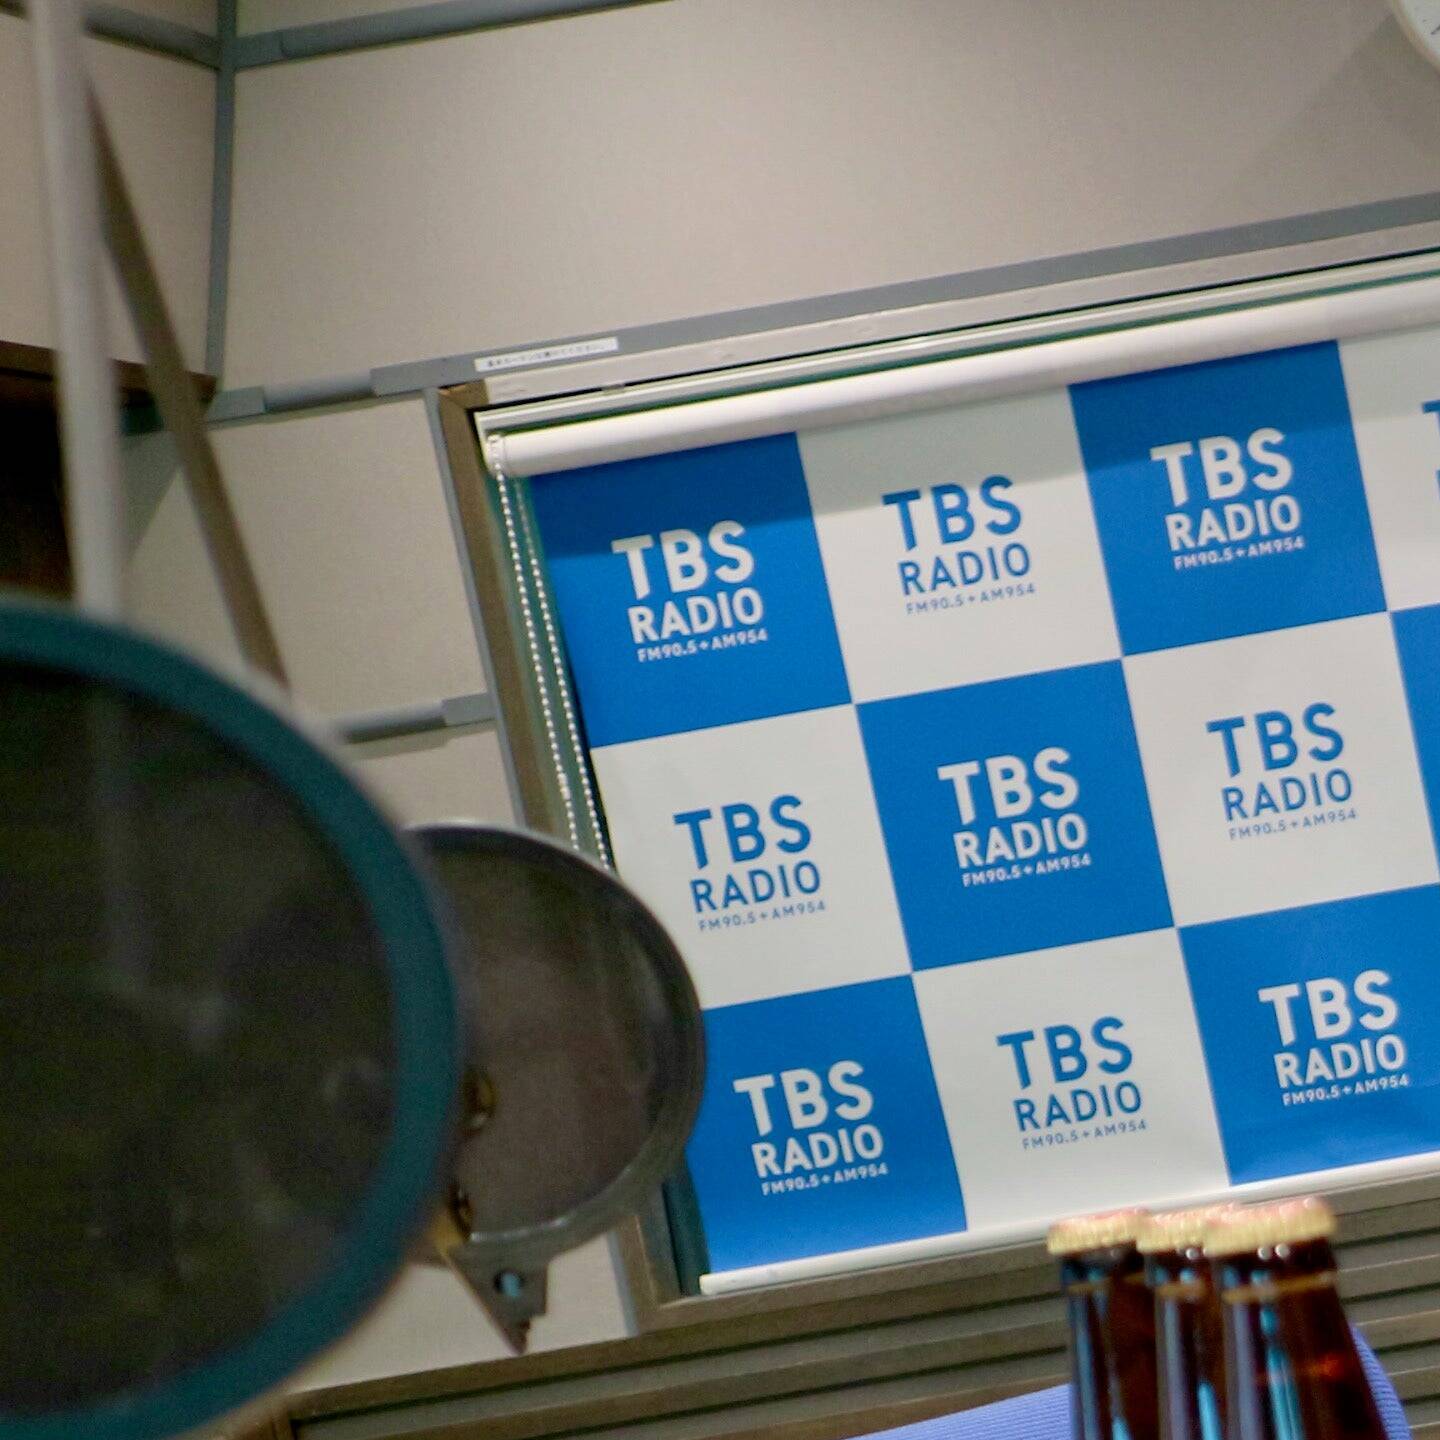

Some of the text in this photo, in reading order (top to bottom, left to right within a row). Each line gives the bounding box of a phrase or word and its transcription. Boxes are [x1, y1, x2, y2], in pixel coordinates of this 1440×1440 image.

[1150, 427, 1294, 508] TBS
[879, 473, 1022, 552] TBS
[1164, 494, 1301, 552] RADIO
[612, 520, 755, 600] TBS
[898, 542, 1031, 596] RADIO
[627, 587, 764, 644] RADIO
[1205, 702, 1345, 778] TBS
[937, 747, 1079, 825] TBS
[1221, 768, 1353, 822] RADIO
[672, 794, 812, 870] TBS
[953, 812, 1088, 869] RADIO
[689, 860, 821, 914] RADIO
[1257, 969, 1399, 1046] TBS
[996, 1016, 1133, 1090] TBS
[1274, 1034, 1407, 1089] RADIO
[732, 1060, 874, 1137] TBS
[1012, 1080, 1142, 1132] RADIO
[751, 1124, 884, 1178] RADIO
